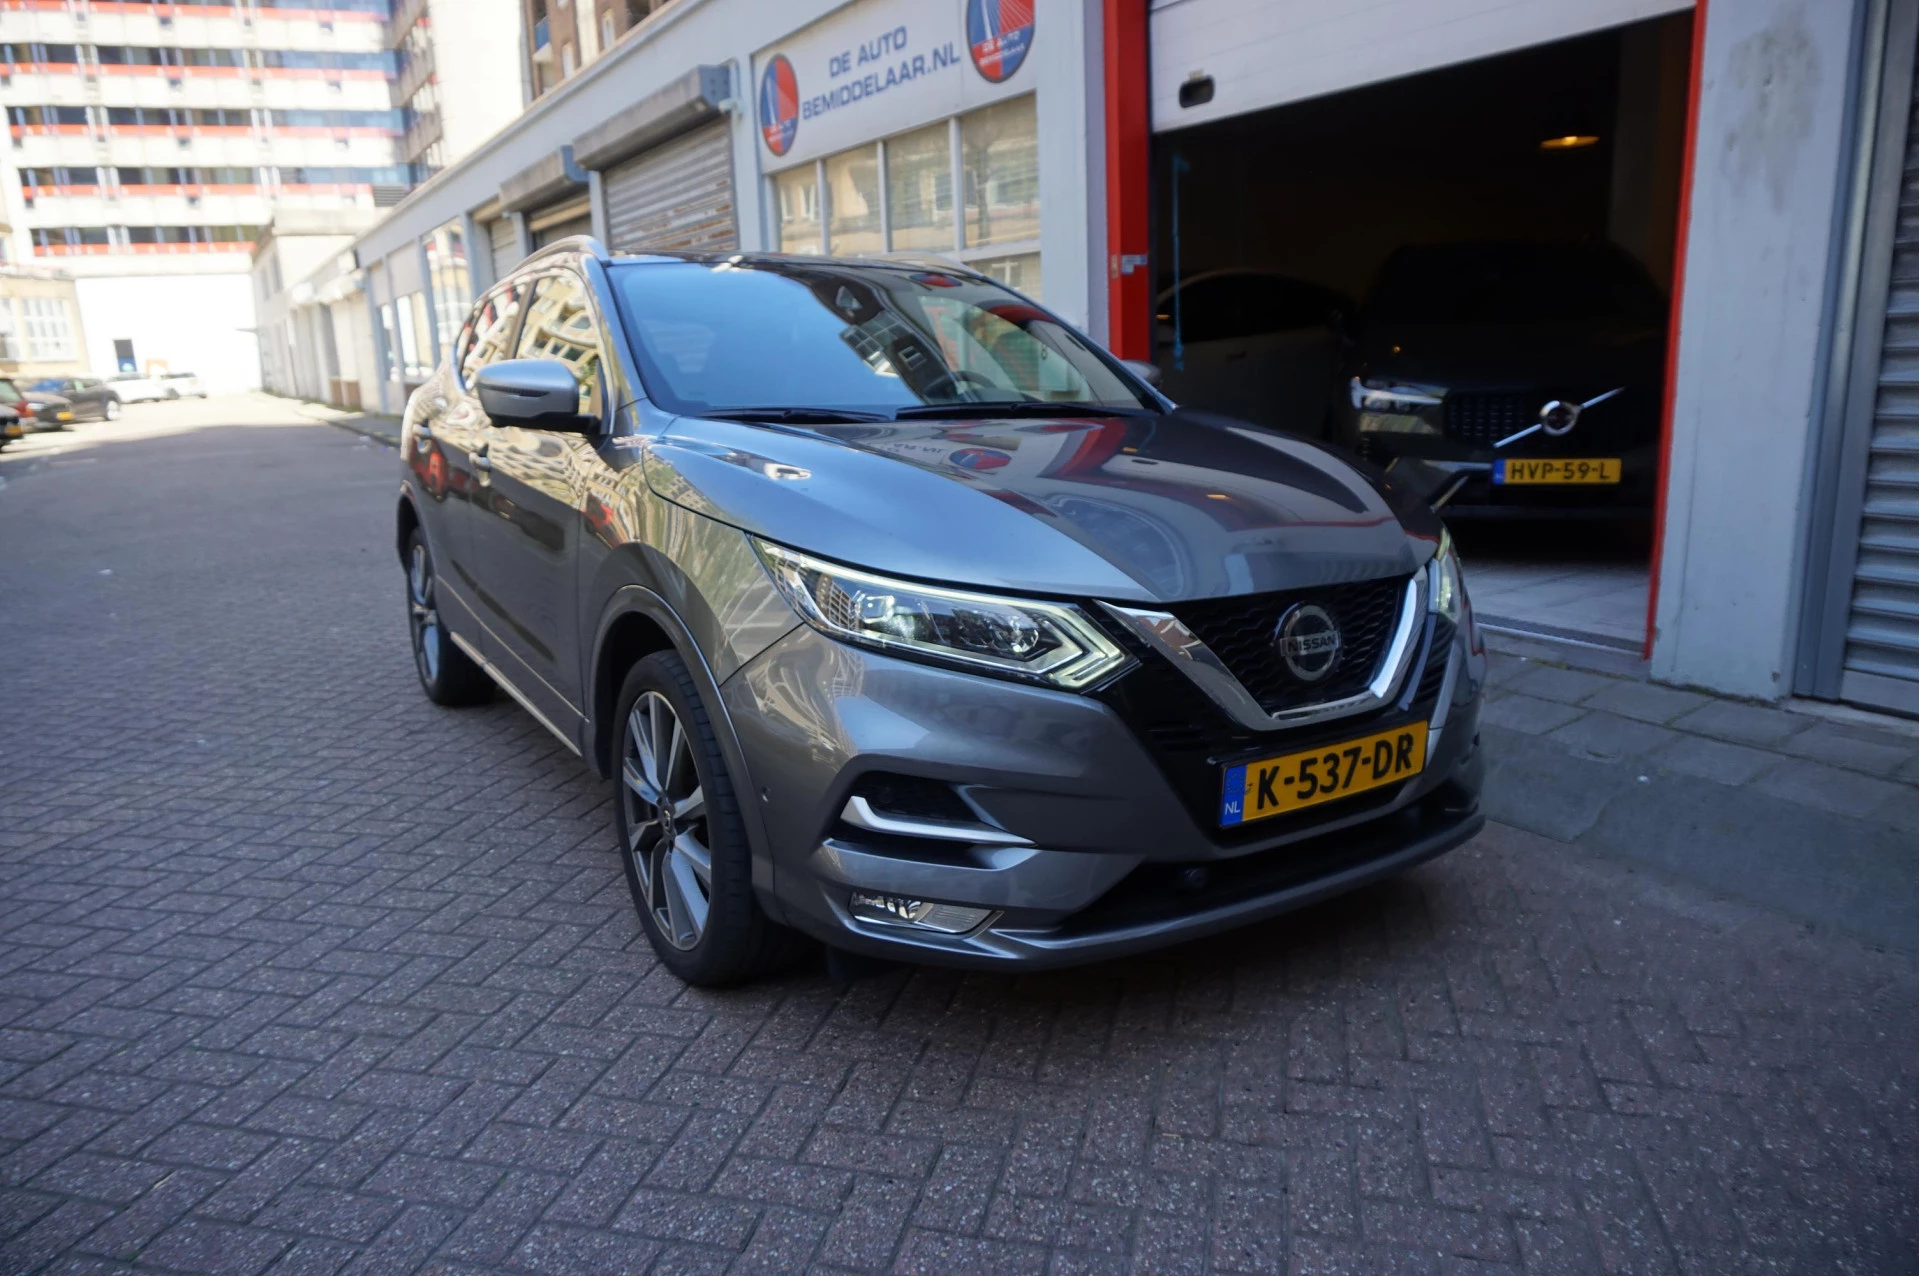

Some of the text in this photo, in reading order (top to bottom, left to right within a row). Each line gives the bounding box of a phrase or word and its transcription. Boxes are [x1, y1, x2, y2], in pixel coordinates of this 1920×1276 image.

[829, 26, 907, 78] DE AUTO
[802, 42, 960, 120] BEMIDDELAAR.NL
[1511, 462, 1610, 479] HVP-59-L
[1287, 633, 1336, 653] NISSAN
[1256, 734, 1414, 810] K-537-DR
[1224, 800, 1241, 816] NL
